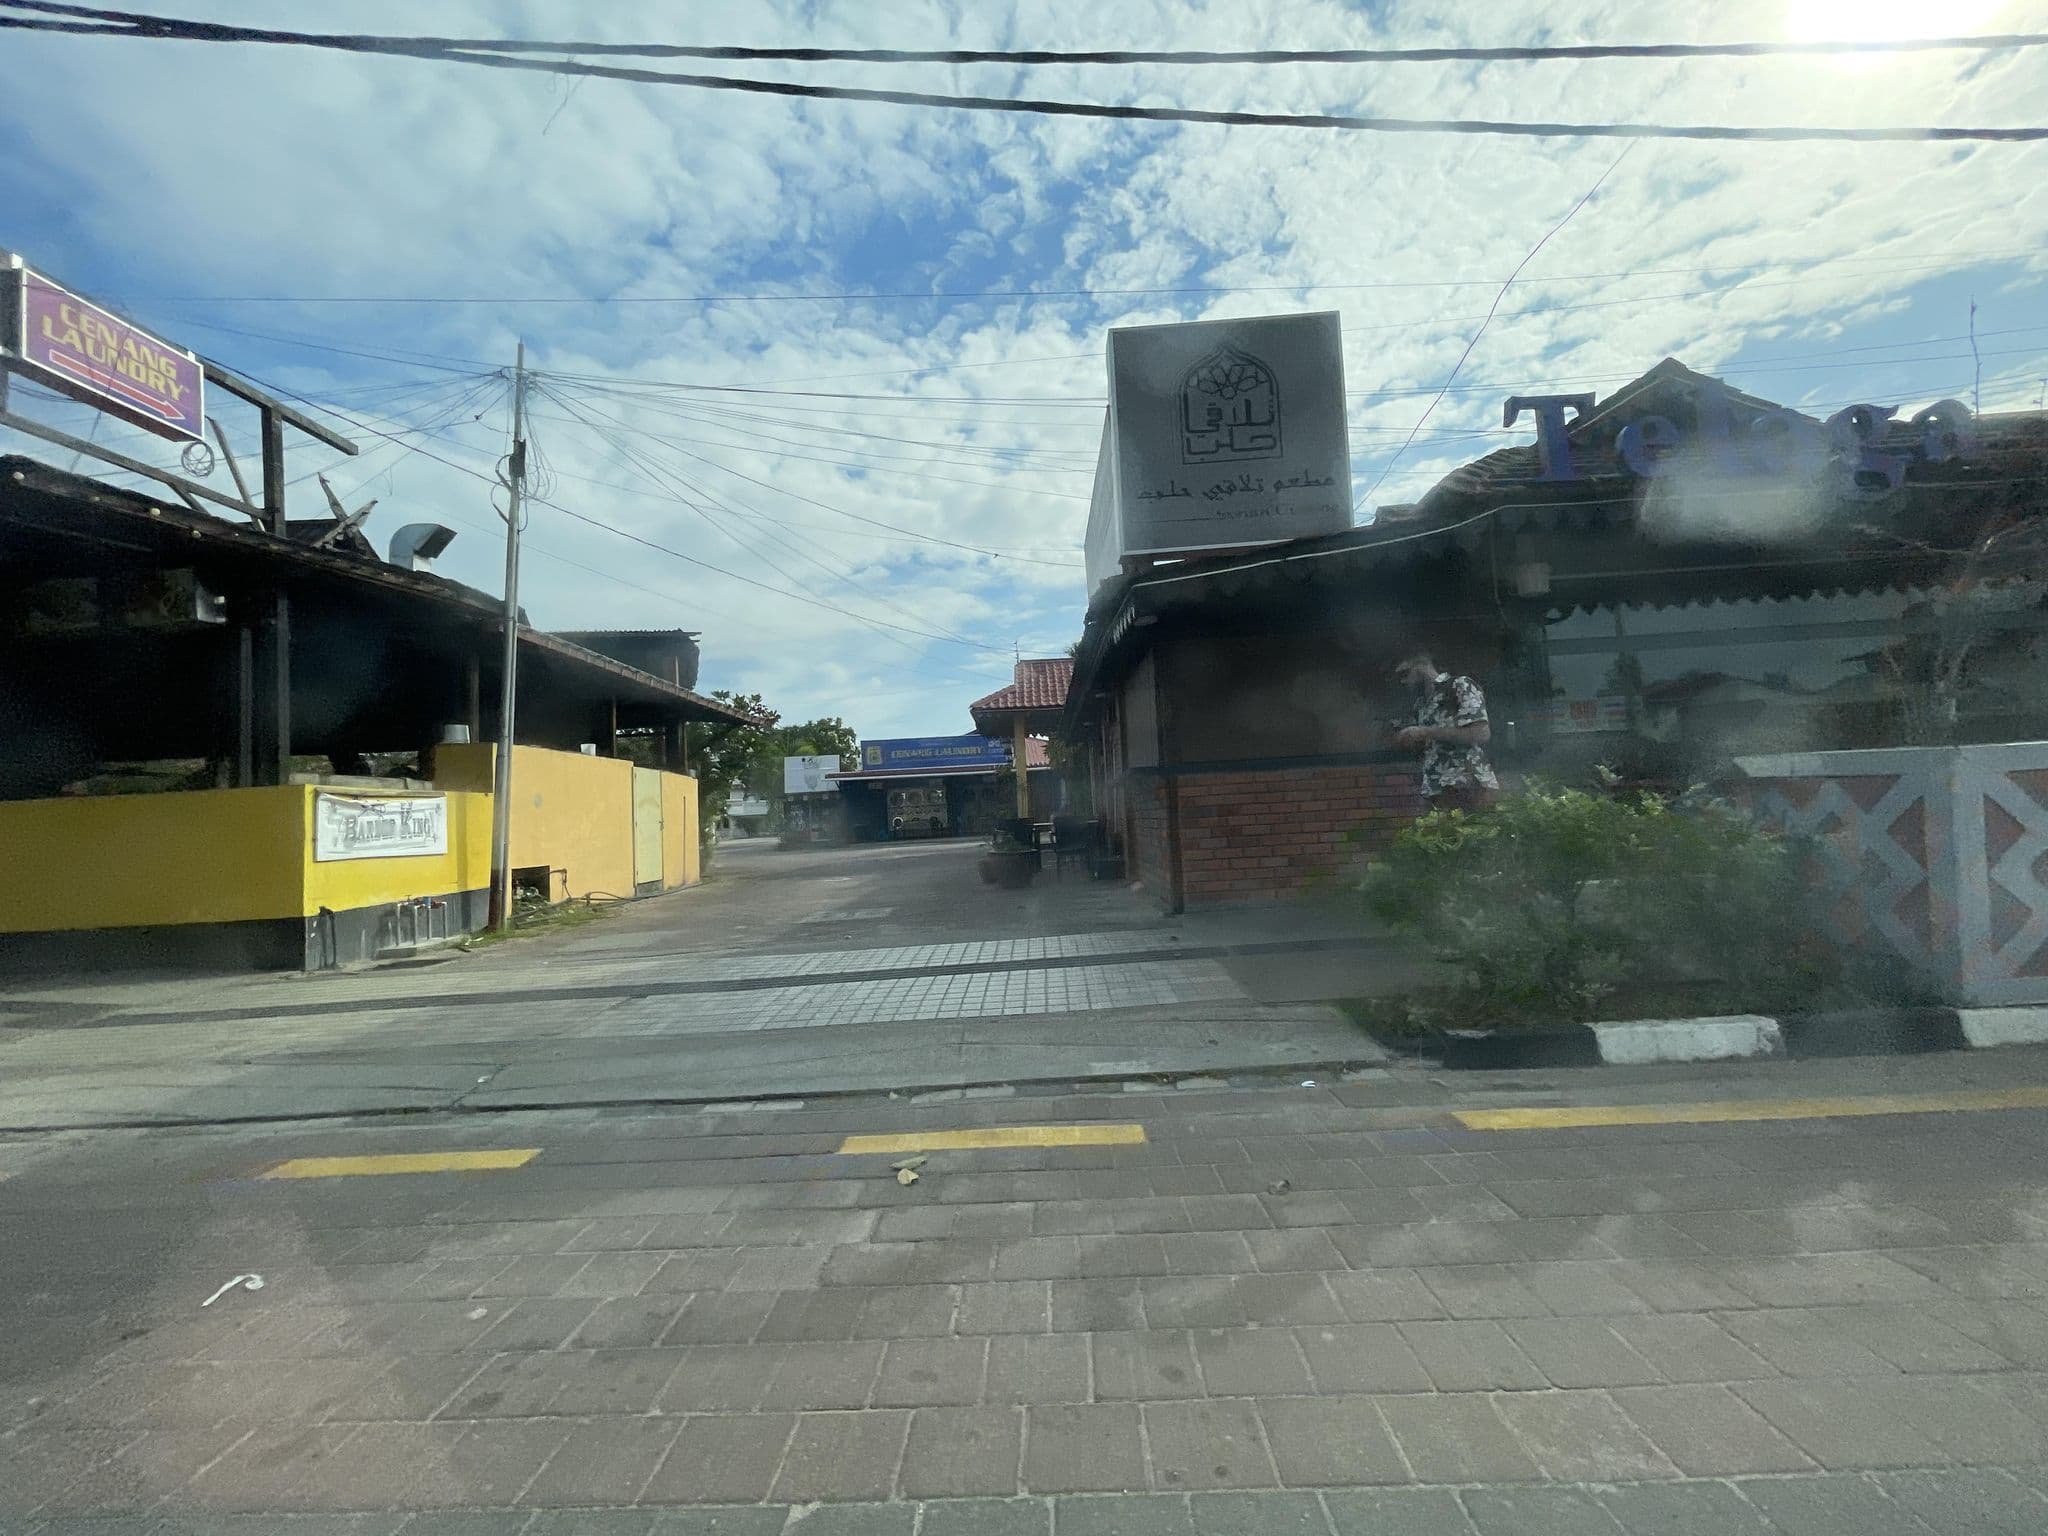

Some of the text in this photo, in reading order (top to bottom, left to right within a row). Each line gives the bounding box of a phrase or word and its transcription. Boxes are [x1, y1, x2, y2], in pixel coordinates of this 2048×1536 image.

[42, 314, 190, 401] LAUNDRY
[60, 303, 177, 379] CENANG
[935, 746, 982, 757] LAUNDRY
